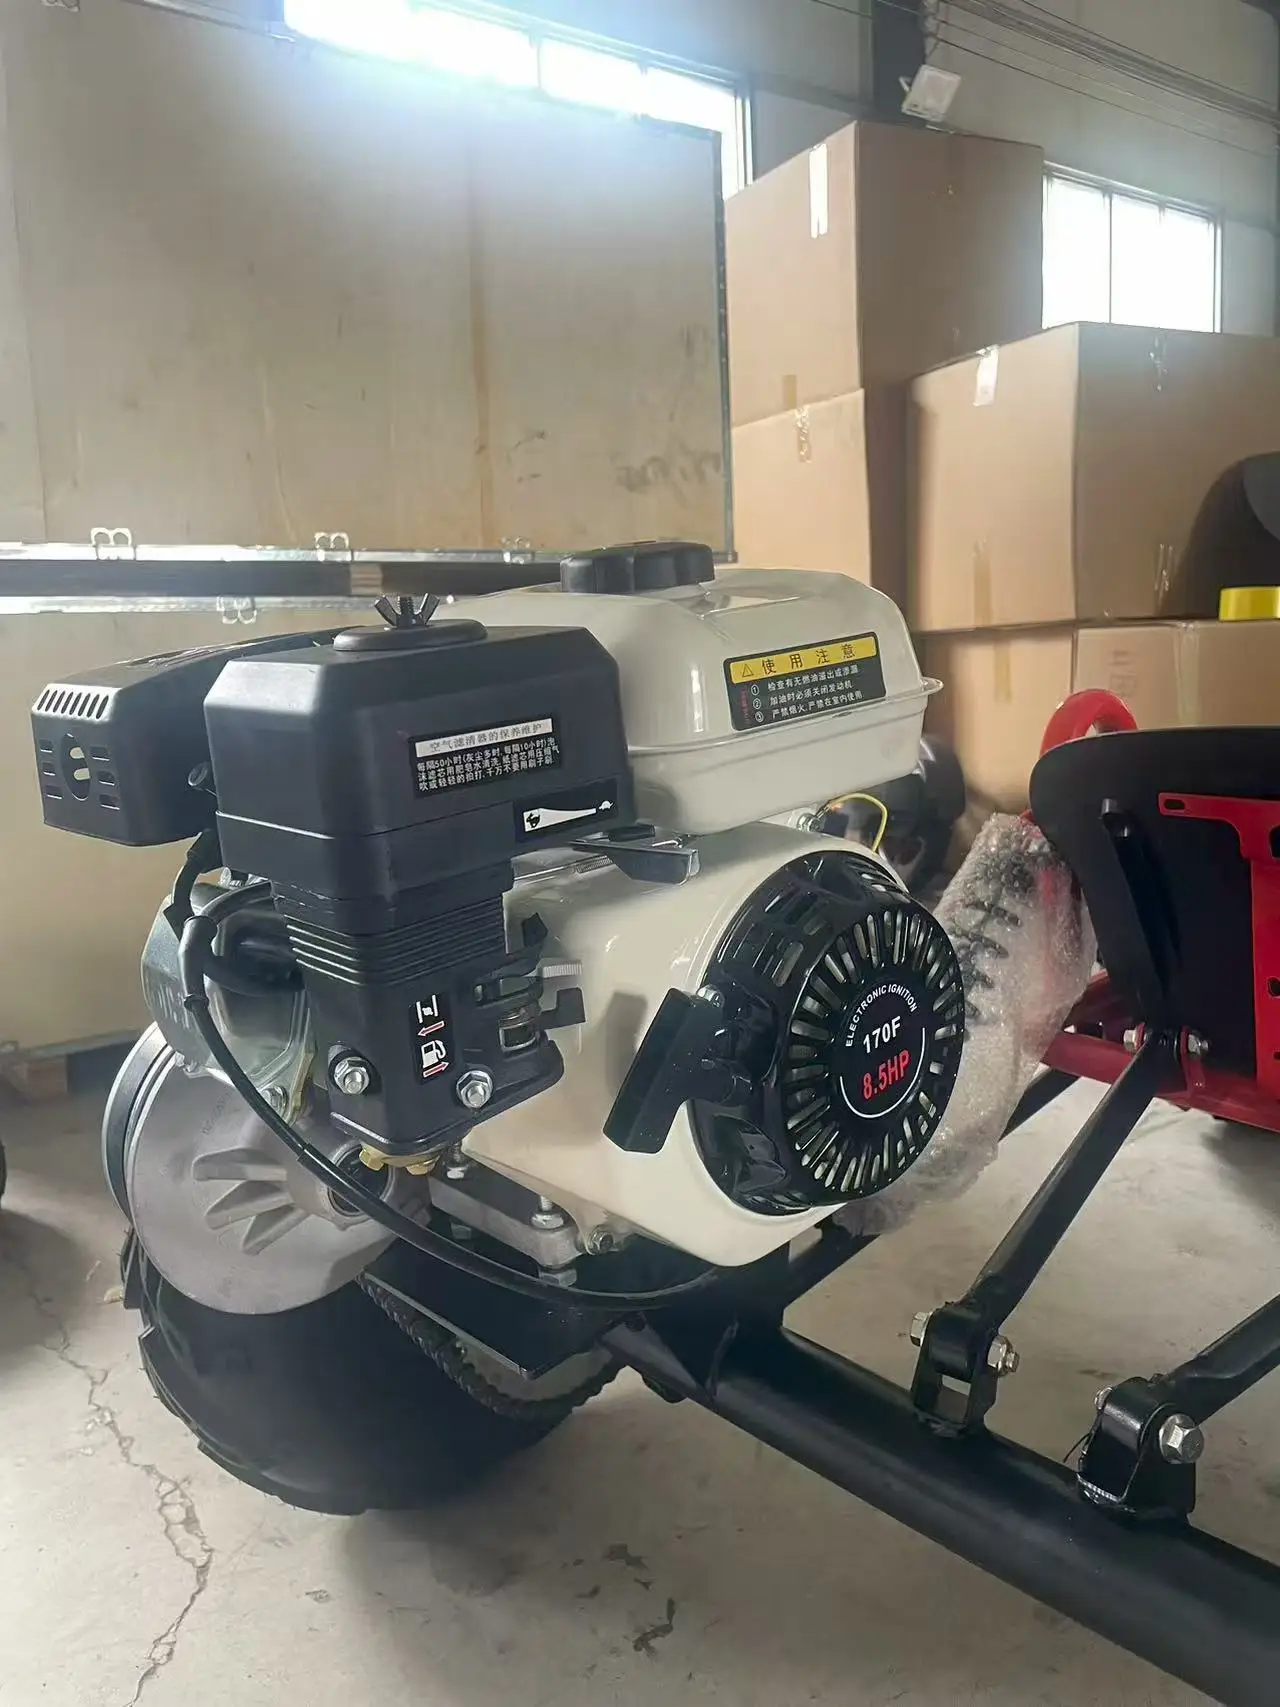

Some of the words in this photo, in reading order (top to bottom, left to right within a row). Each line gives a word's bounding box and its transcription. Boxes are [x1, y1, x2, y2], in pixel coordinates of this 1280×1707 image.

[762, 644, 855, 674] 使用注意
[769, 680, 852, 706] 加油时必须关闭发动机
[430, 723, 542, 751] 空气滤清器的保养维护
[845, 985, 887, 1047] ELECTRONIC
[888, 983, 918, 1012] IGNITION
[863, 1015, 901, 1054] 170F
[863, 1049, 910, 1100] 8.5HP
